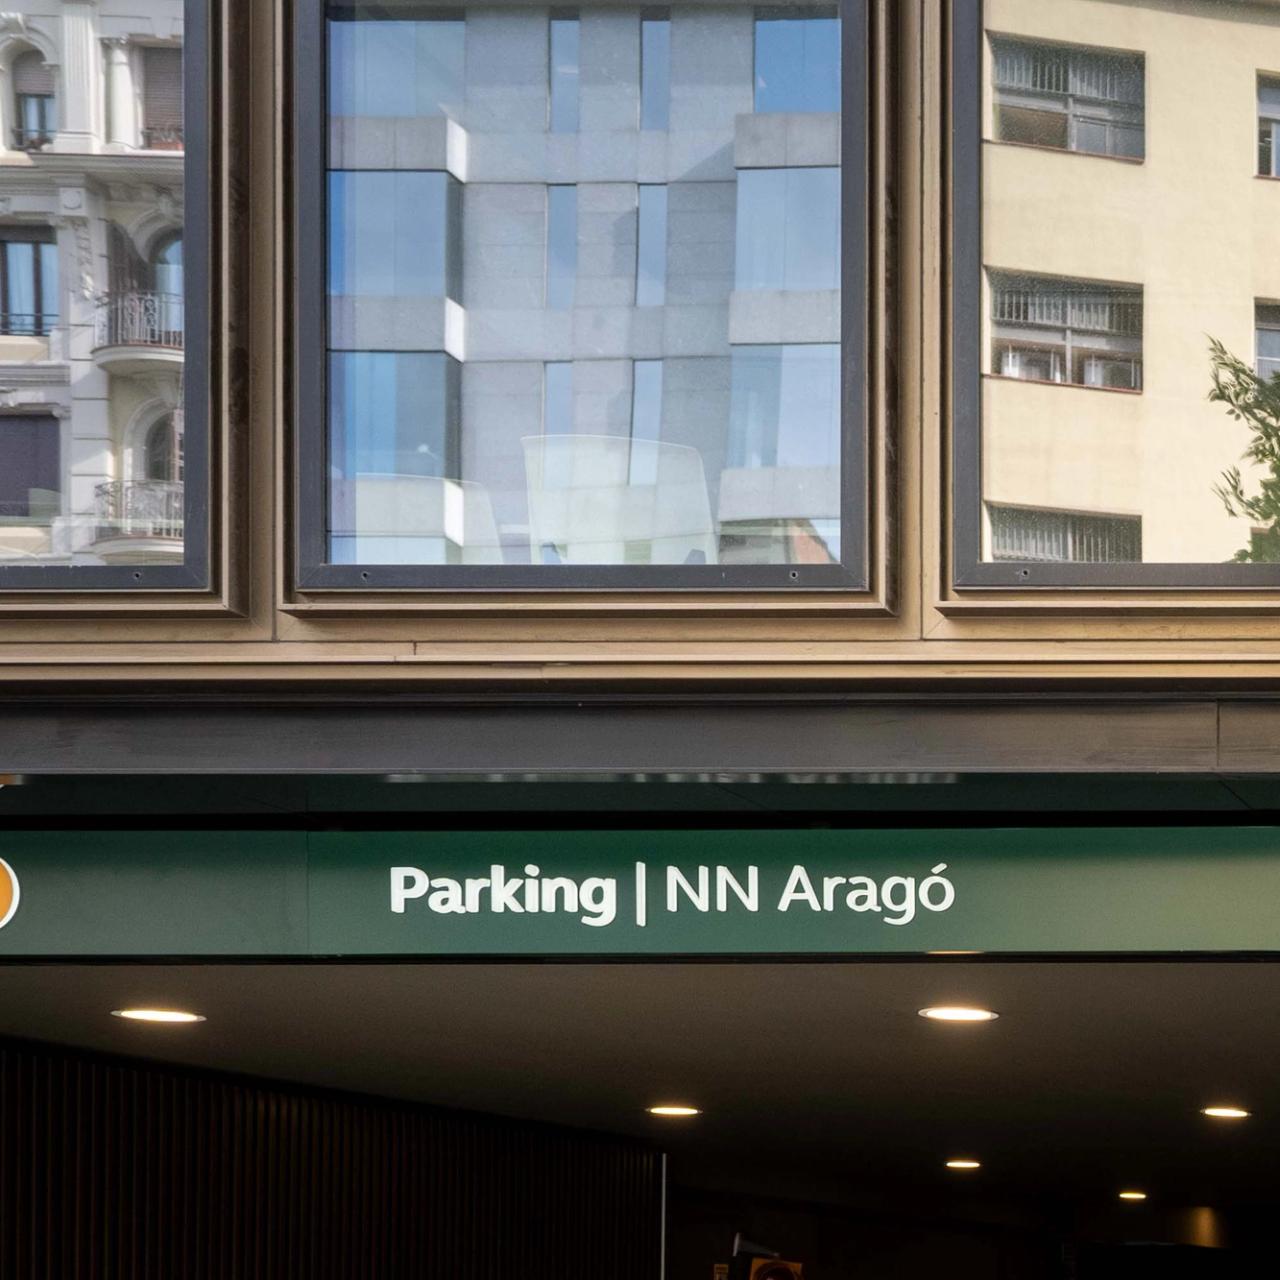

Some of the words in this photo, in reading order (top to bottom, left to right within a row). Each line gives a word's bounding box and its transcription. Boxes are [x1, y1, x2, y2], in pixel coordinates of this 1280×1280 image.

[388, 863, 618, 928] Parking
[666, 865, 760, 913] NN
[778, 862, 957, 927] Aragó
